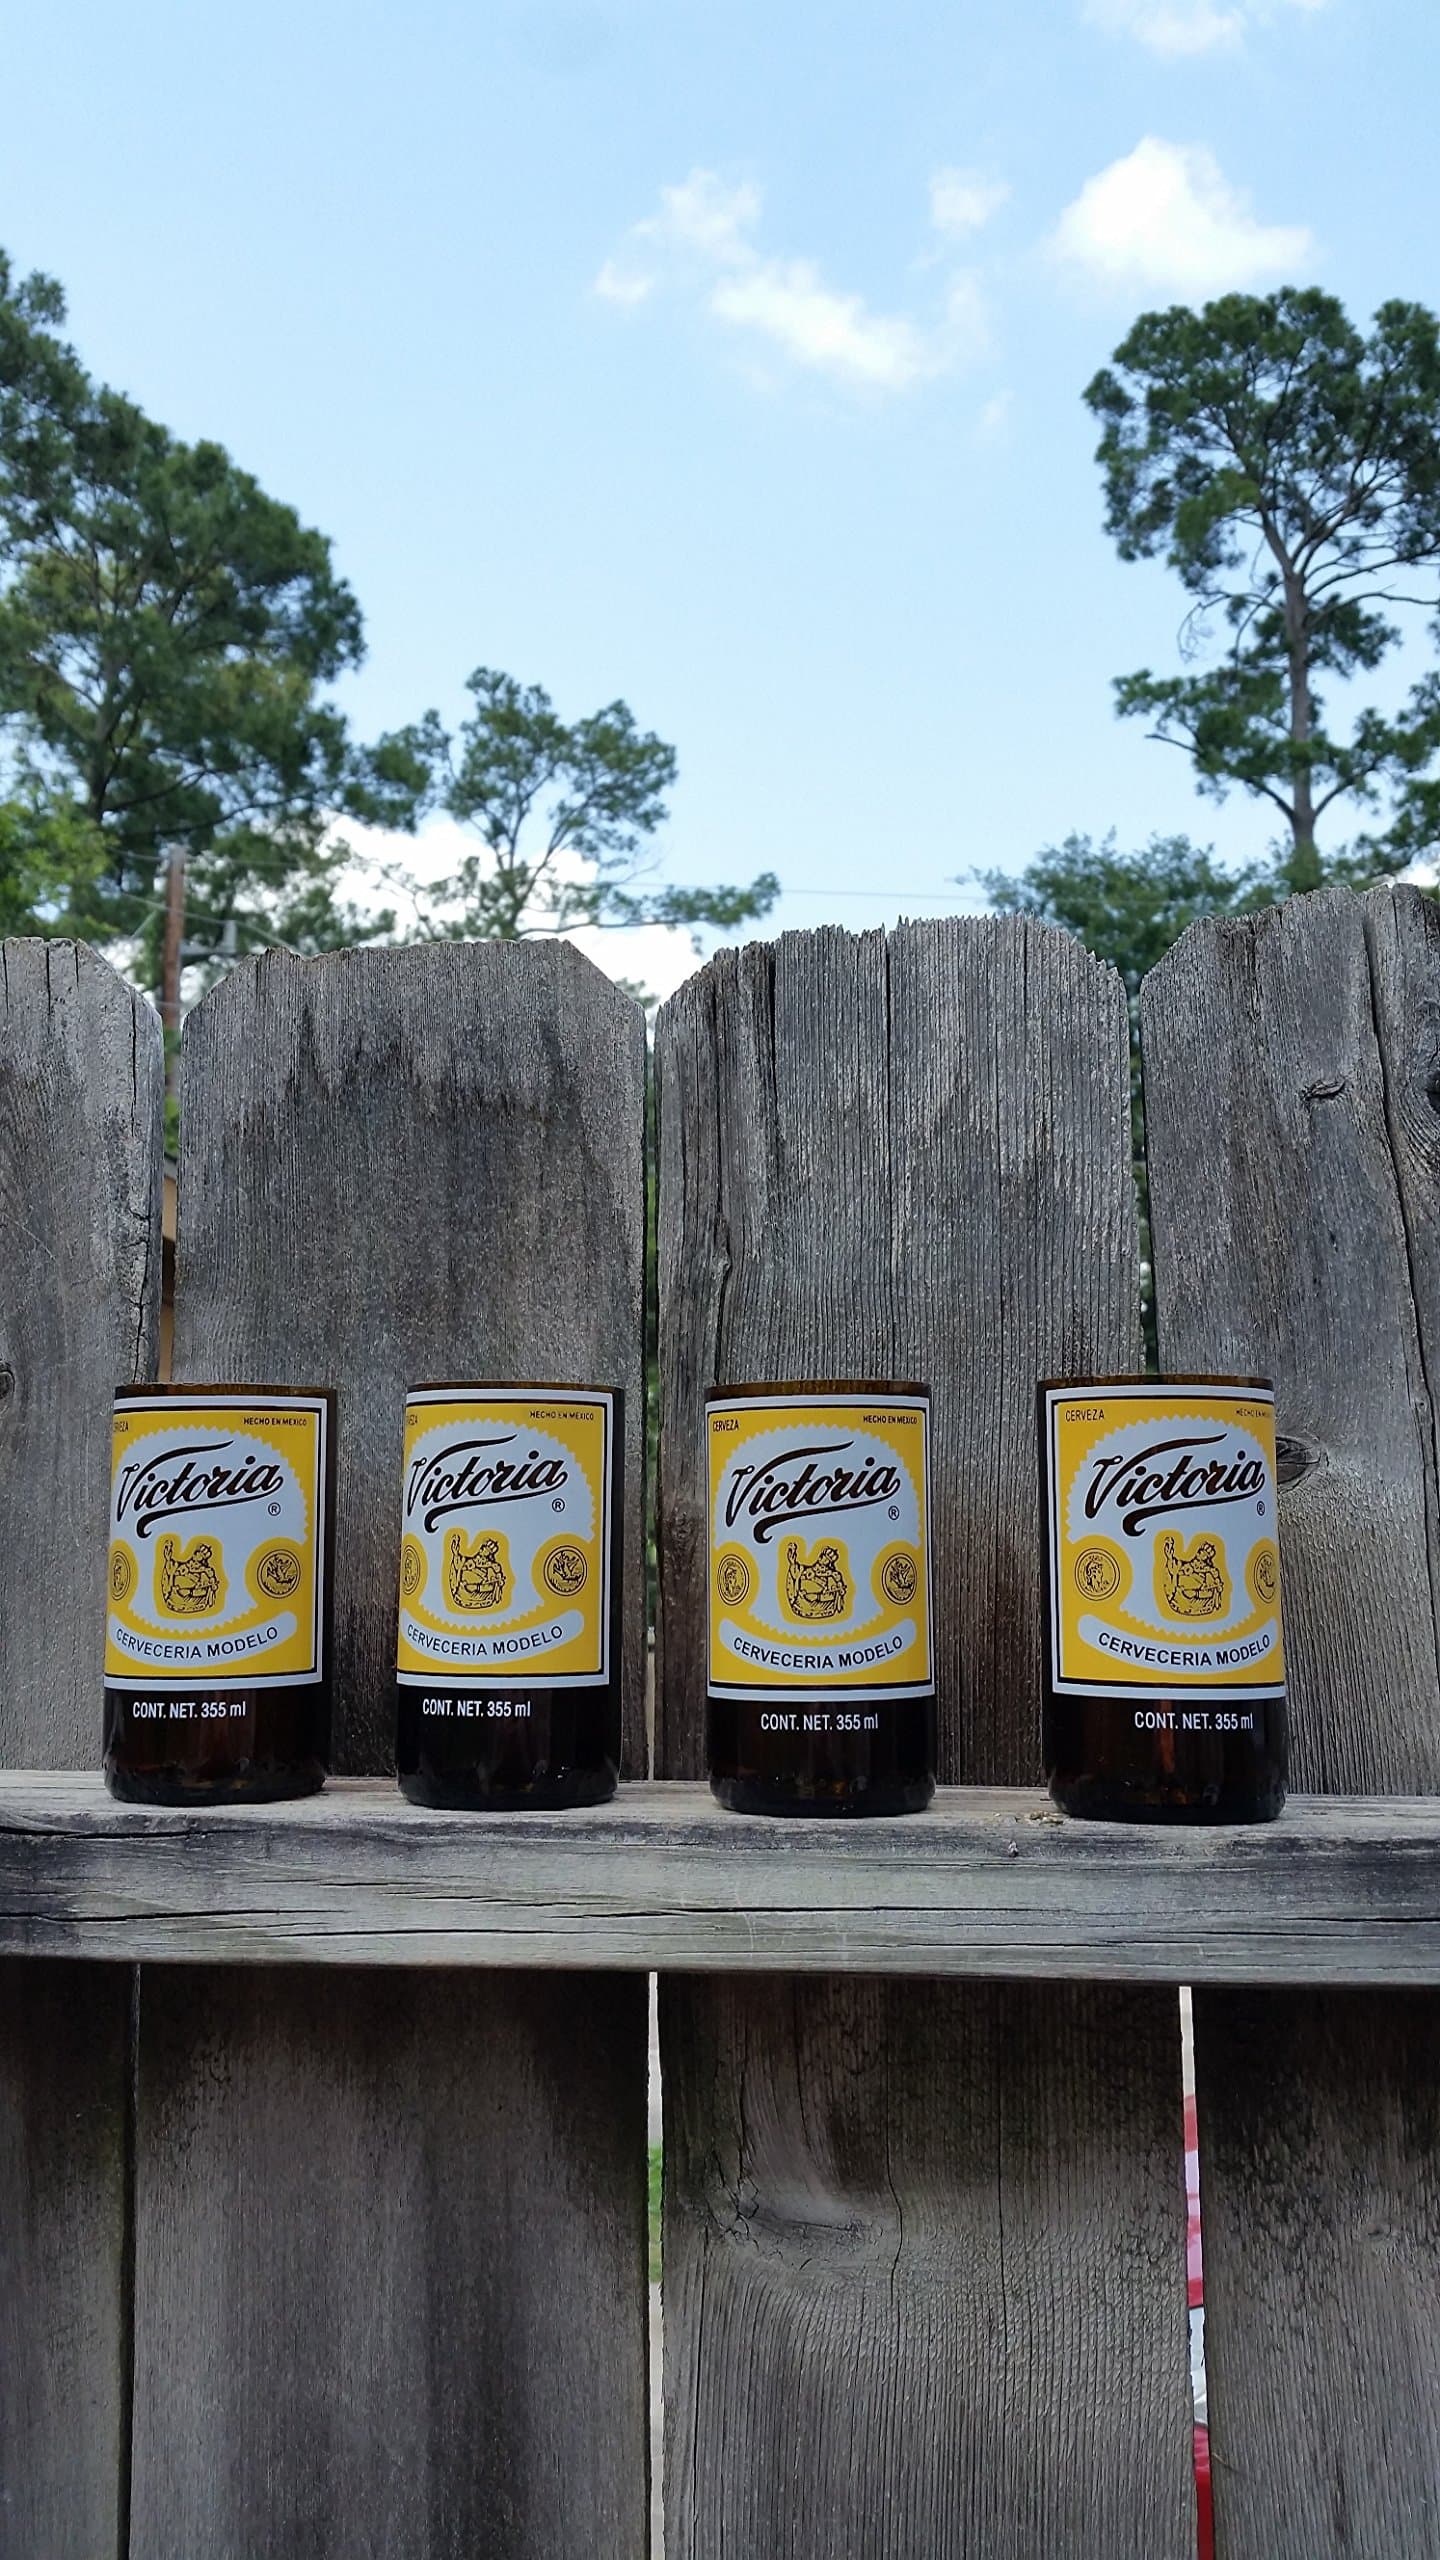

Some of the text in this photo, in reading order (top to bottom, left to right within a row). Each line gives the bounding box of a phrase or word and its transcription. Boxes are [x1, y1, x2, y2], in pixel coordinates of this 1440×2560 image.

[243, 1417, 270, 1426] HECHO
[712, 1419, 740, 1433] CERVEZA
[863, 1415, 887, 1424] HECHO
[1065, 1409, 1105, 1422] CERVEZA
[117, 1440, 283, 1538] Victoria
[407, 1434, 568, 1533] Victoria
[726, 1440, 900, 1544] Victoria
[1085, 1433, 1265, 1537] Victoria
[117, 1626, 278, 1659] CERVECERIA MODELO
[407, 1624, 563, 1656] CERVECERIA MODELO
[733, 1635, 903, 1669] CERVECERIA MODELO
[1099, 1632, 1271, 1666] CERVECERIA MODELO
[132, 1701, 246, 1719] CONT. NET. 355 ml
[422, 1699, 531, 1717] CONT. NET. 355 ml
[1134, 1711, 1254, 1730] CONT. NET. 355 ml
[760, 1713, 879, 1731] CONT. NET. 355 ml
